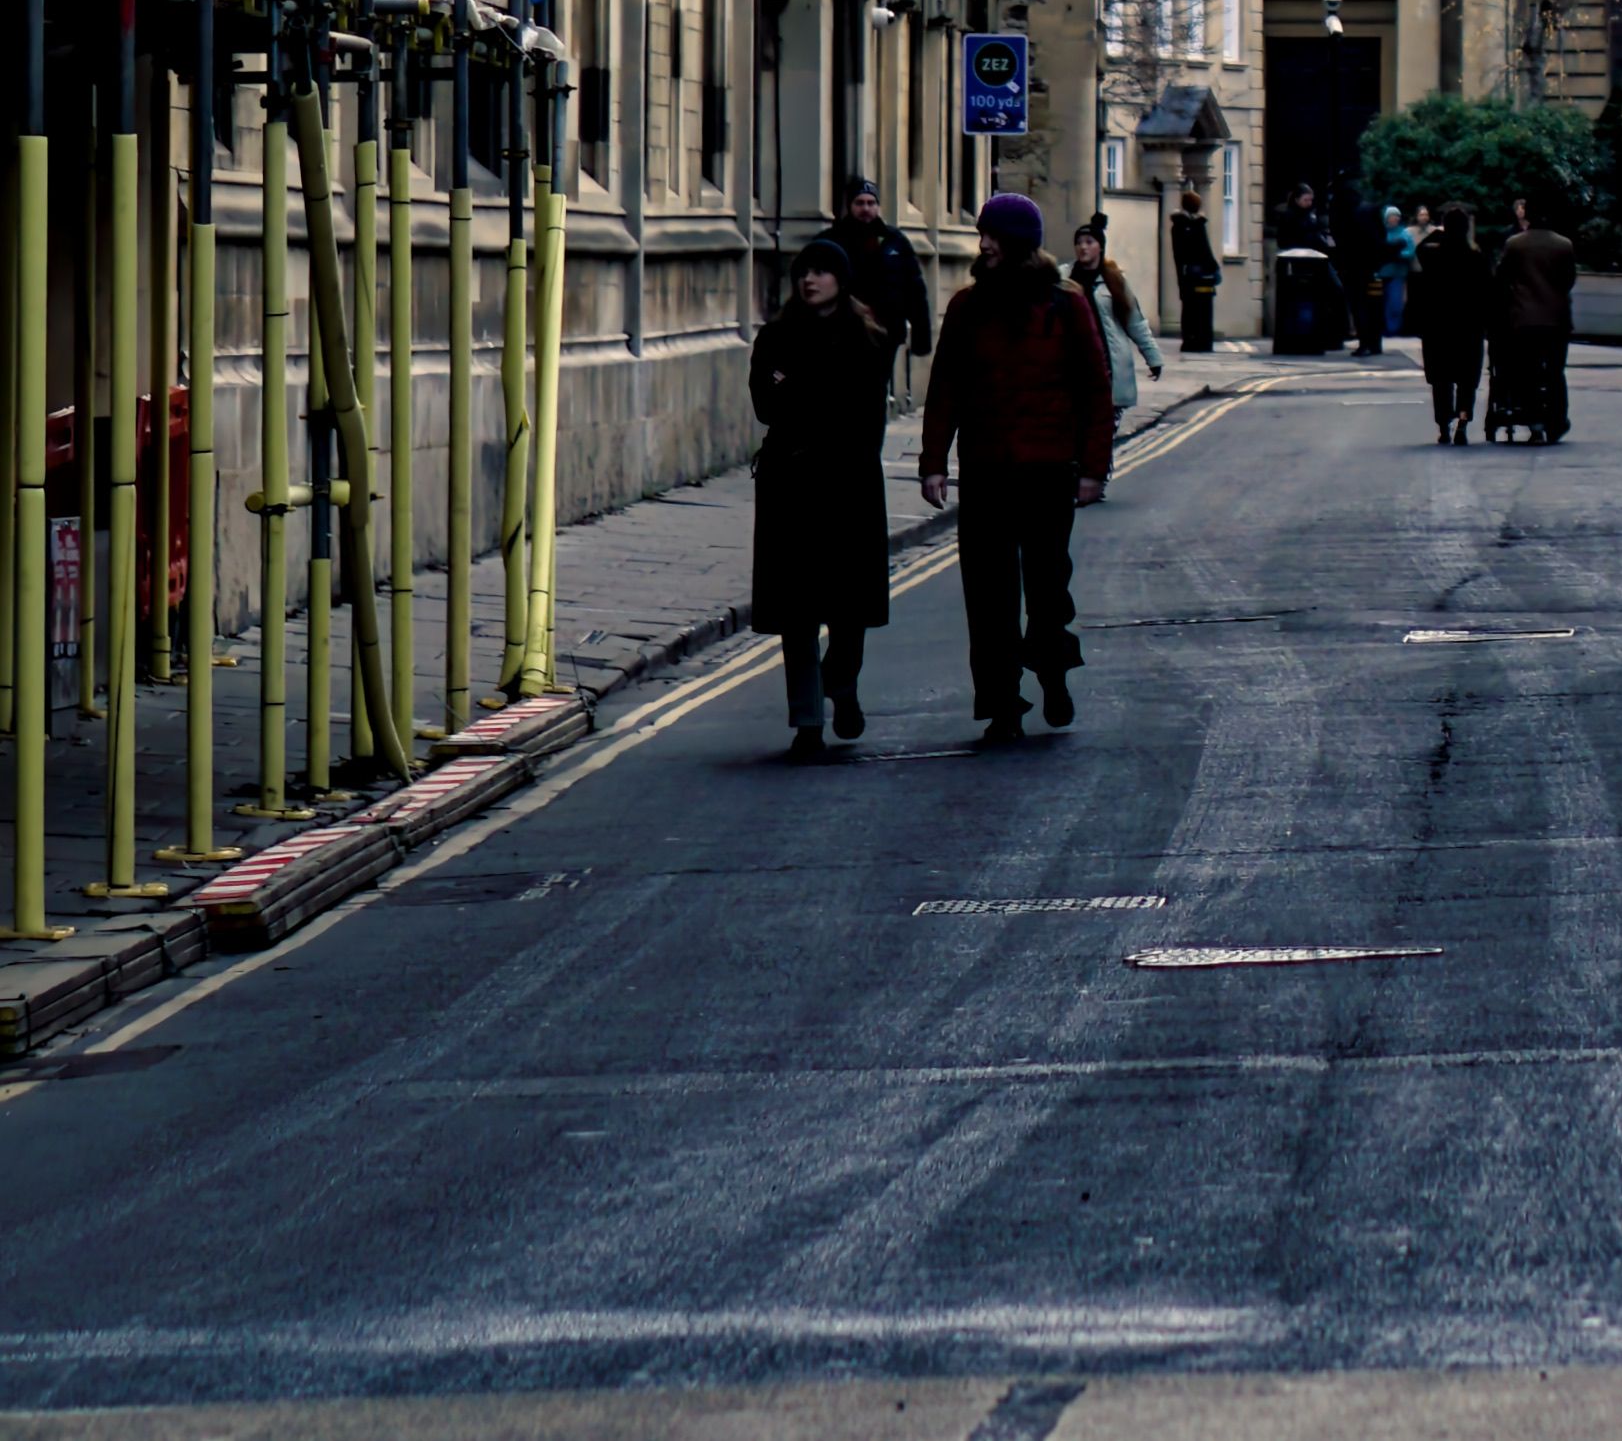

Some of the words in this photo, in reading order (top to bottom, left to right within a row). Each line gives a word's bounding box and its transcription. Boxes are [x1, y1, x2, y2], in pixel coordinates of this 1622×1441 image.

[981, 58, 1010, 71] ZEZ
[970, 95, 996, 108] 100
[998, 95, 1021, 110] yds
